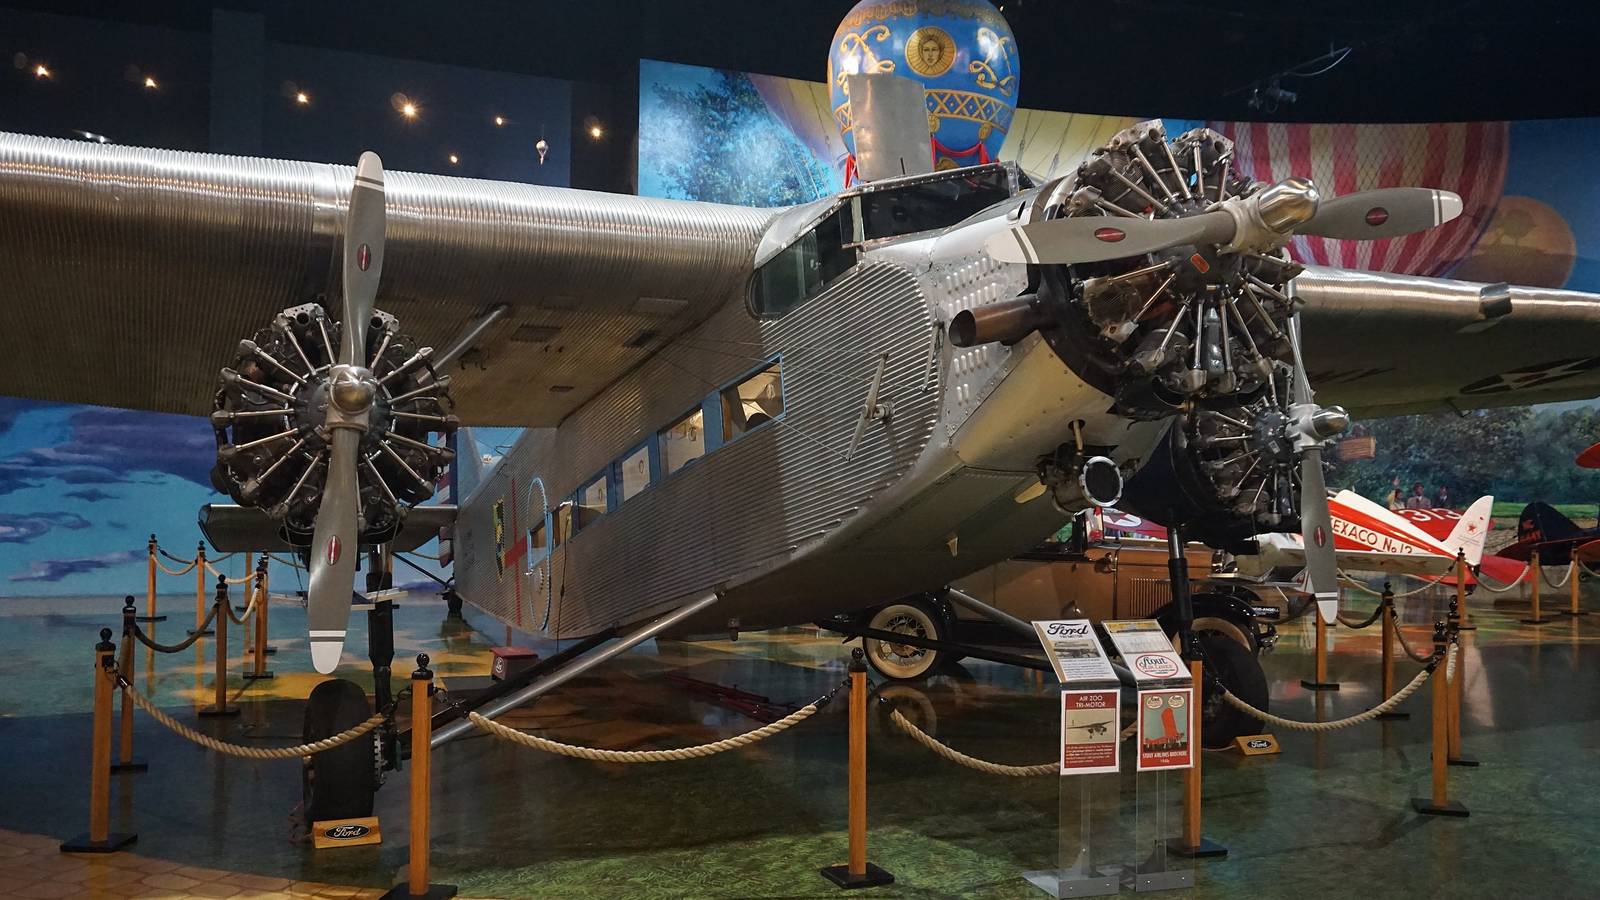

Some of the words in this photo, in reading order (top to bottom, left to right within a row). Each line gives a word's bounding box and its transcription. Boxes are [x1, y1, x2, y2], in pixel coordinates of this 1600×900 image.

[1332, 517, 1378, 545] EXACO
[1047, 623, 1088, 635] Ford
[1251, 740, 1268, 748] Ford
[333, 826, 361, 837] Ford
